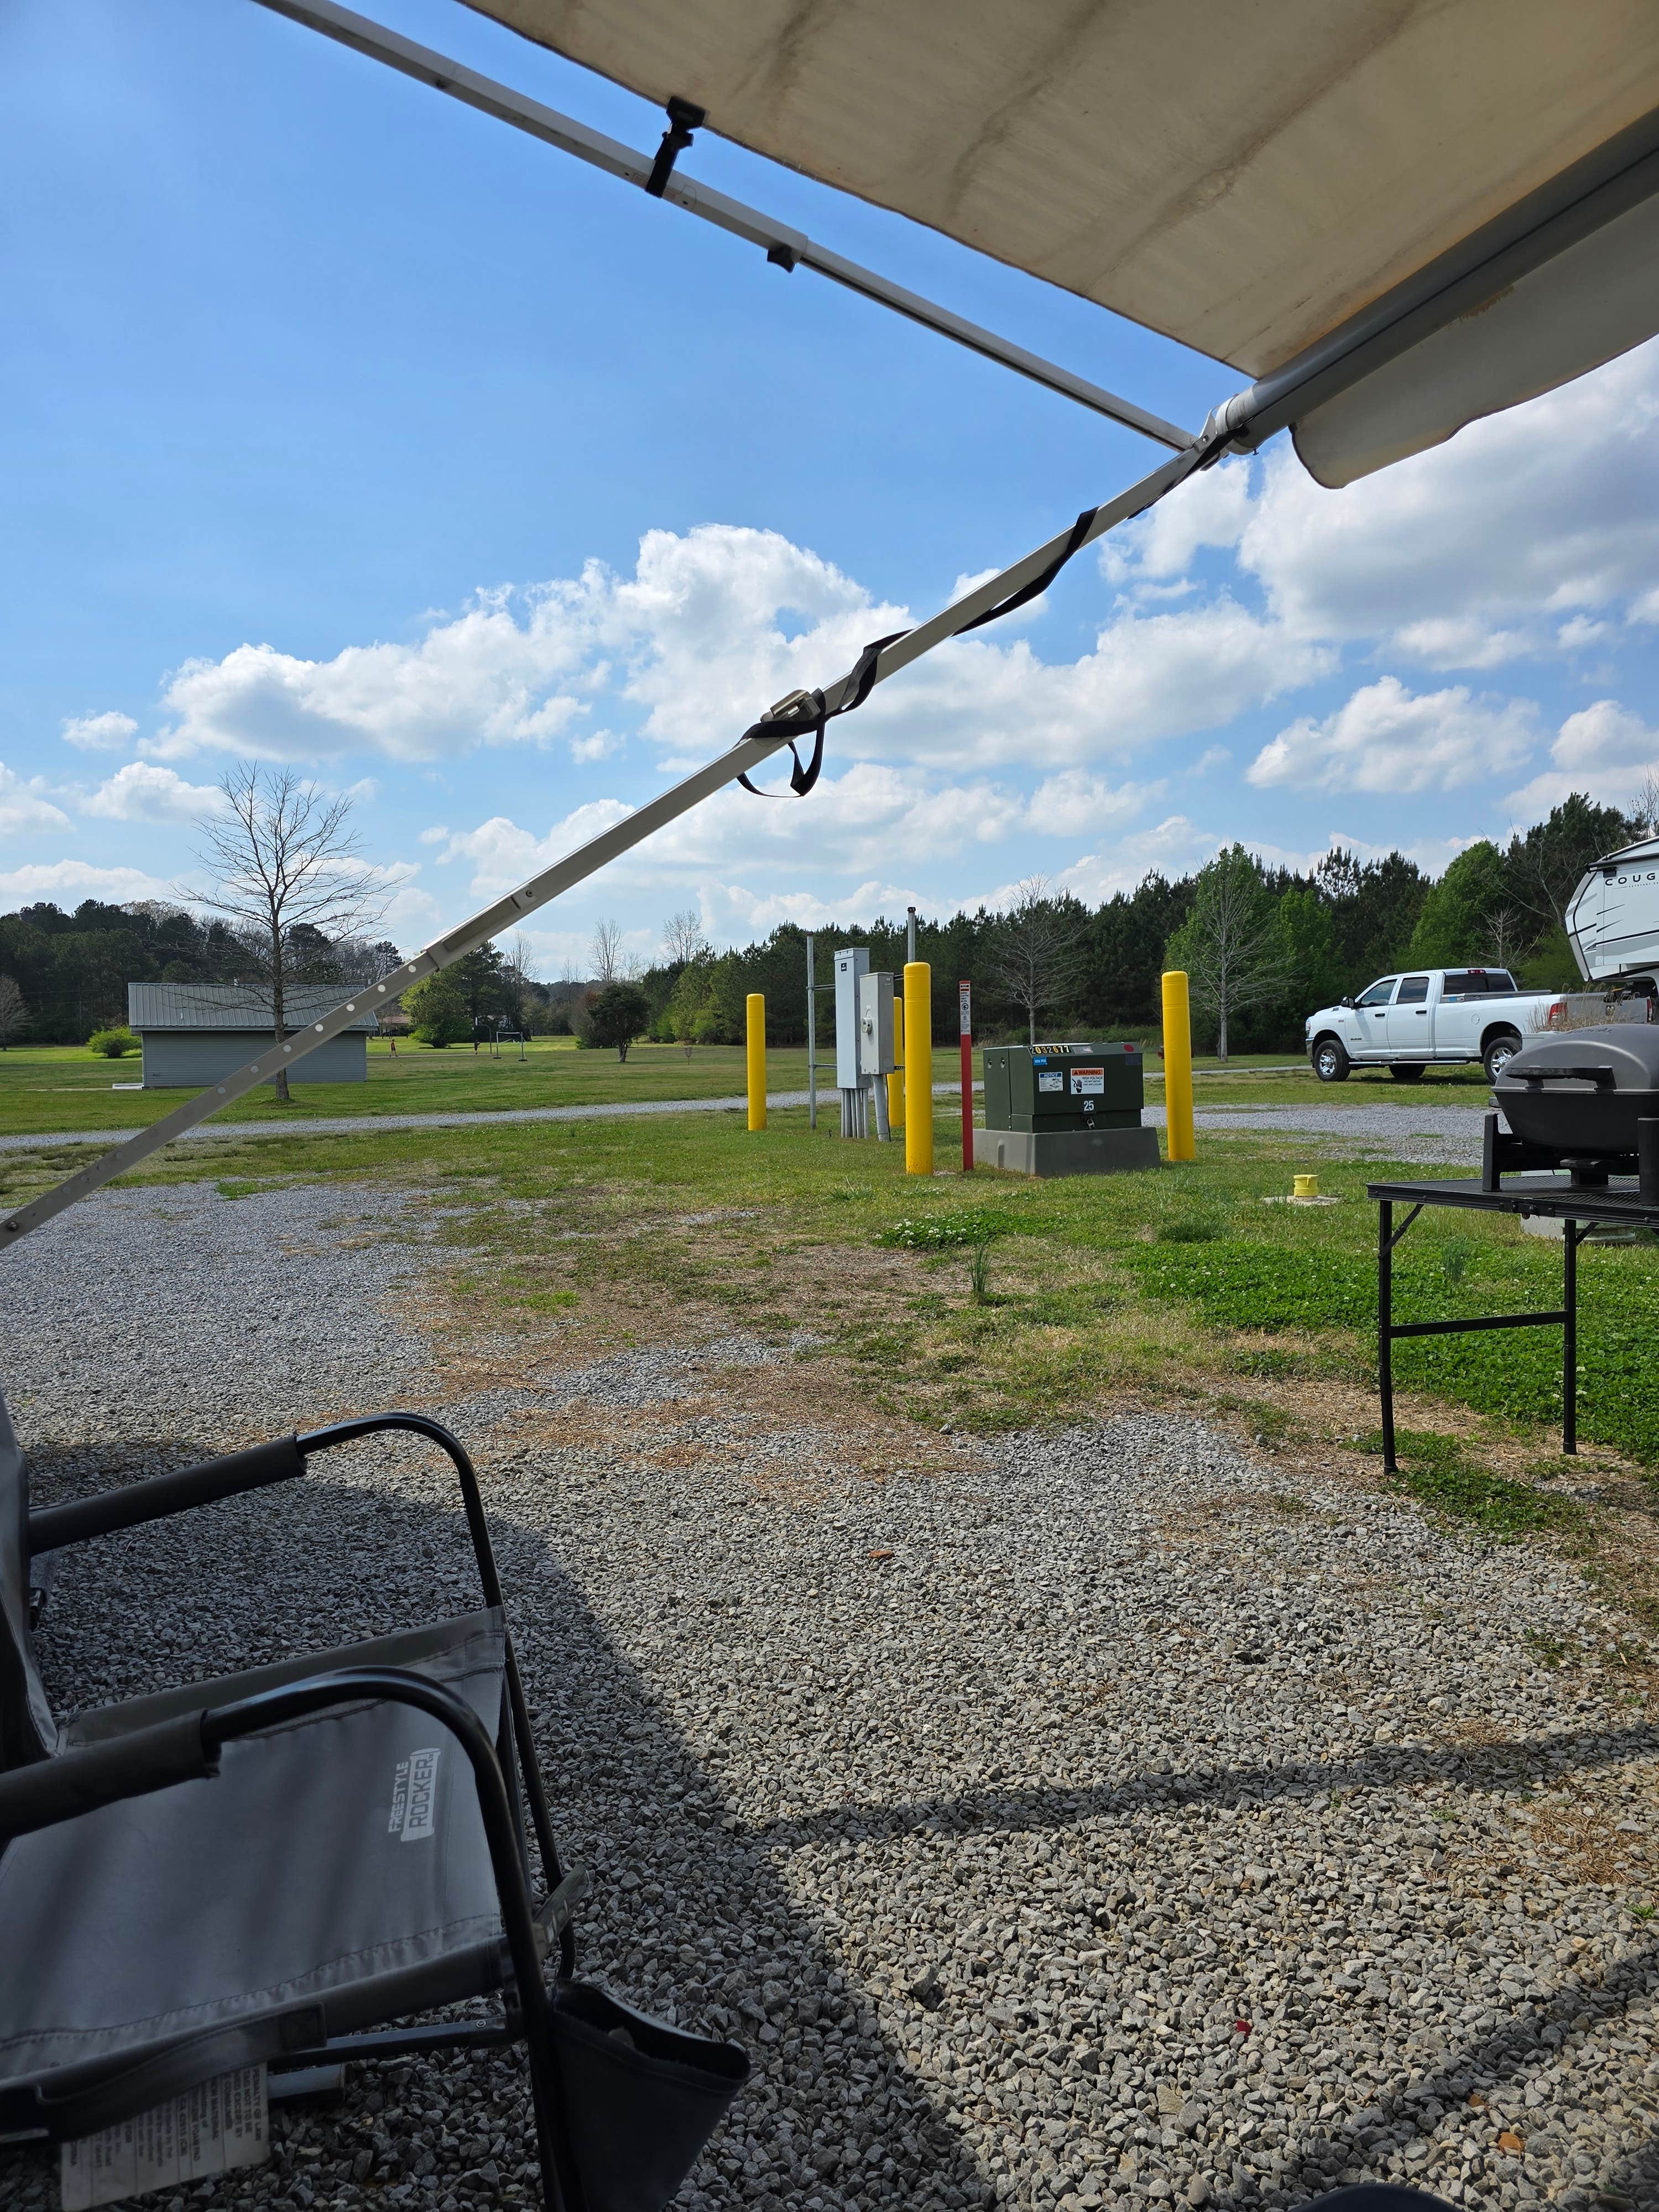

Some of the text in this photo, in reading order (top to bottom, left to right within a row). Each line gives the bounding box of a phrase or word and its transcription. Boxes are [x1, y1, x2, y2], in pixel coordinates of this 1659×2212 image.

[1029, 1045, 1070, 1054] 2032677
[1084, 1100, 1094, 1112] 25
[388, 1761, 409, 1833] FREESTYLE
[409, 1759, 434, 1829] ROCKER
[245, 2109, 252, 2121] TO
[254, 2108, 262, 2119] OF
[236, 2127, 243, 2139] BY
